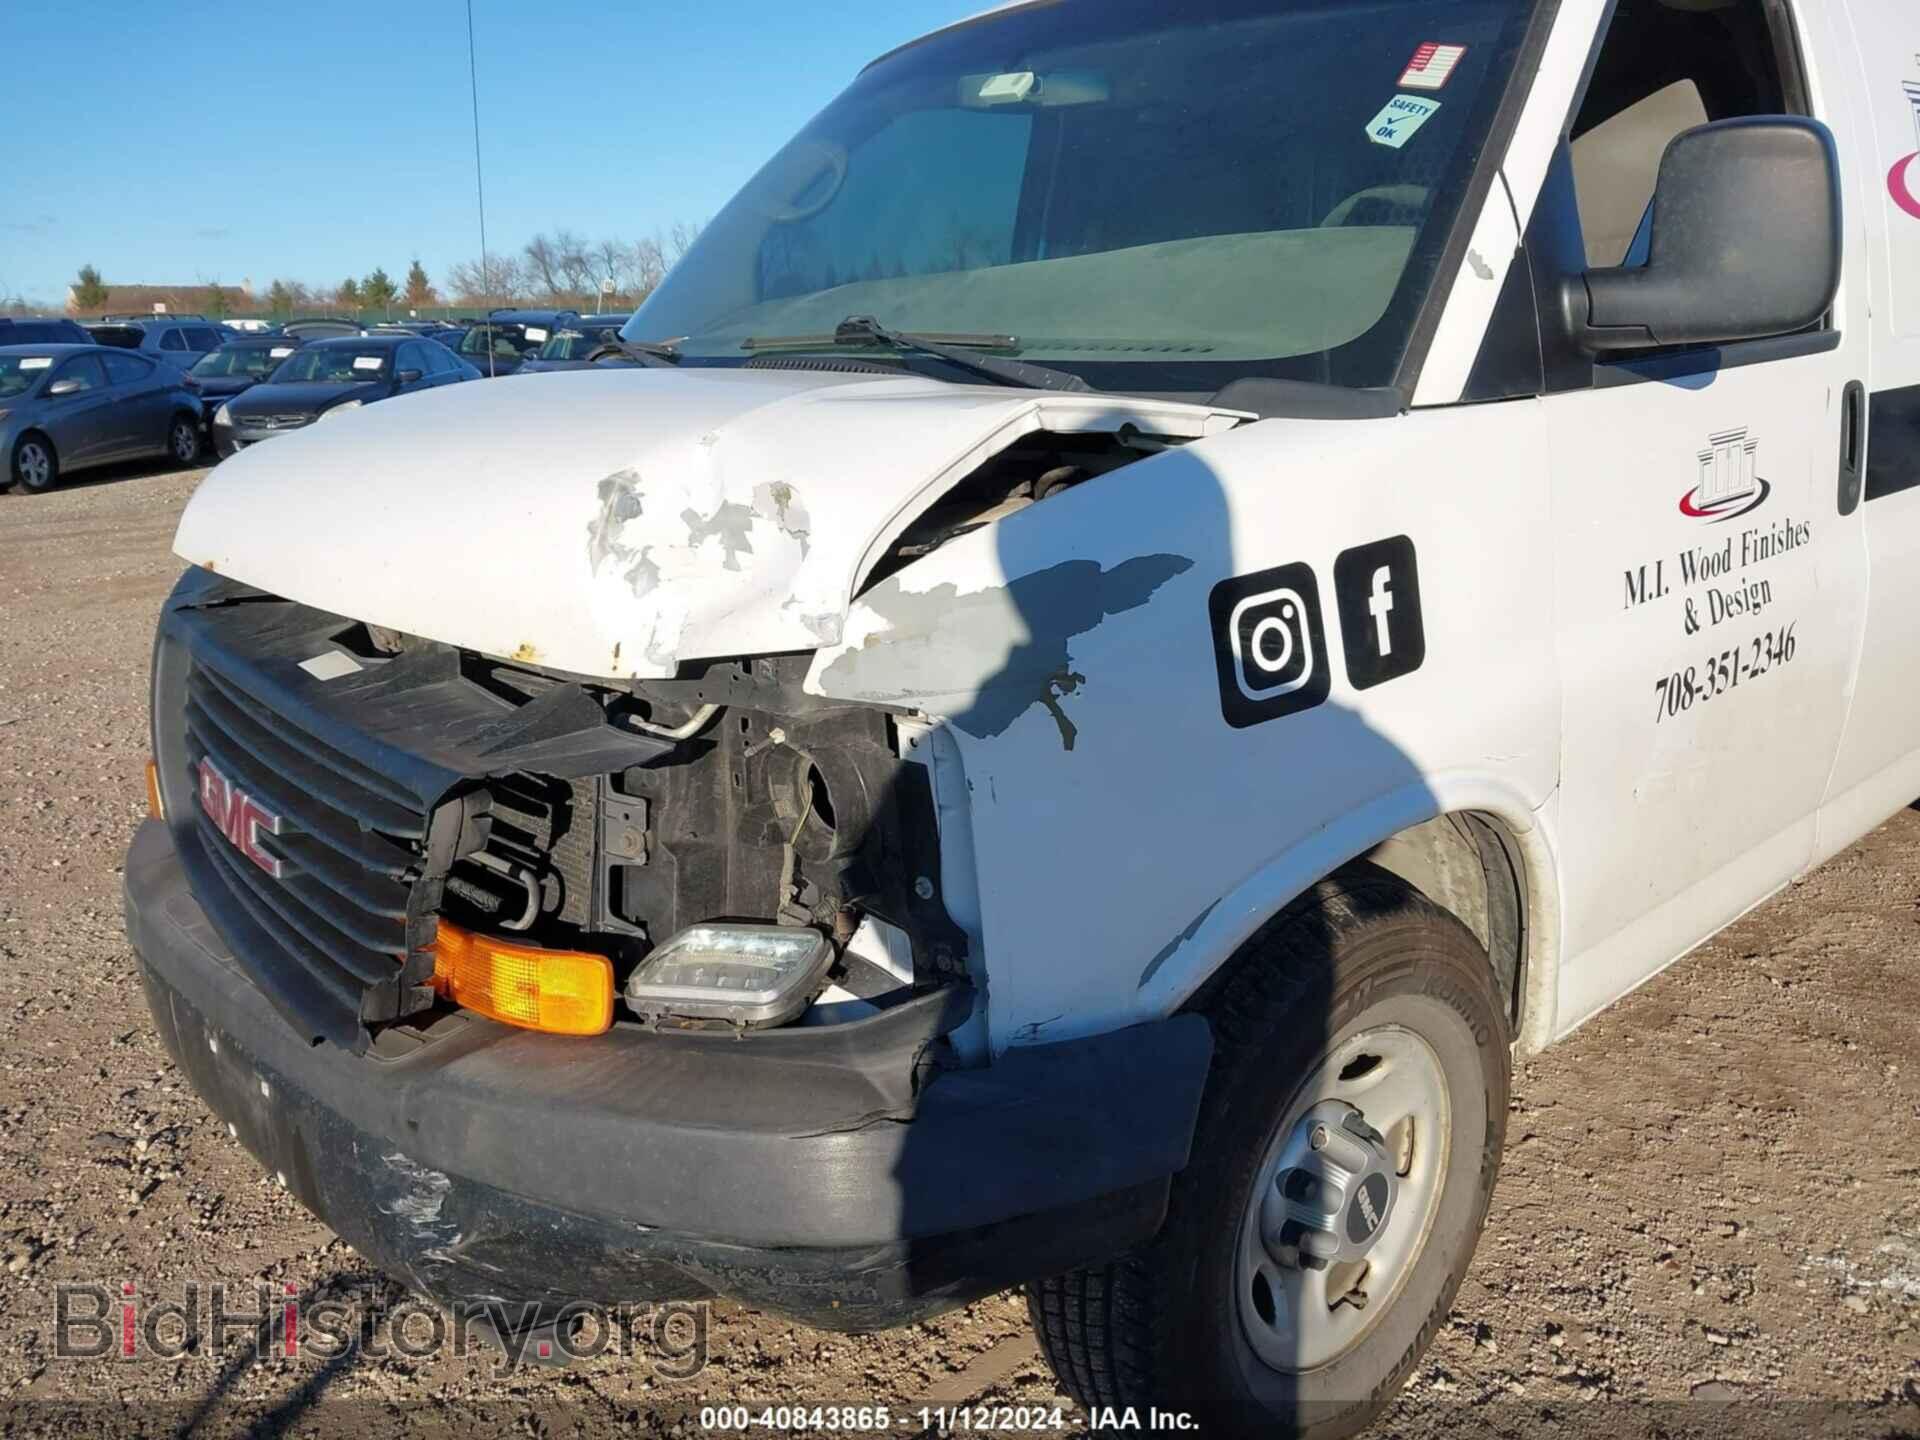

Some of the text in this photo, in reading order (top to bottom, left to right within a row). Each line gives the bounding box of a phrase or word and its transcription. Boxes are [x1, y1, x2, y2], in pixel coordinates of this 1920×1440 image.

[1376, 126, 1397, 139] OK
[1390, 99, 1432, 116] SAFETY
[1623, 518, 1811, 610] M.I. Wood Finishes
[1684, 577, 1773, 636] & Design
[1655, 618, 1797, 724] 708-351-2346
[198, 755, 281, 879] GMC
[1357, 1184, 1379, 1232] GMC
